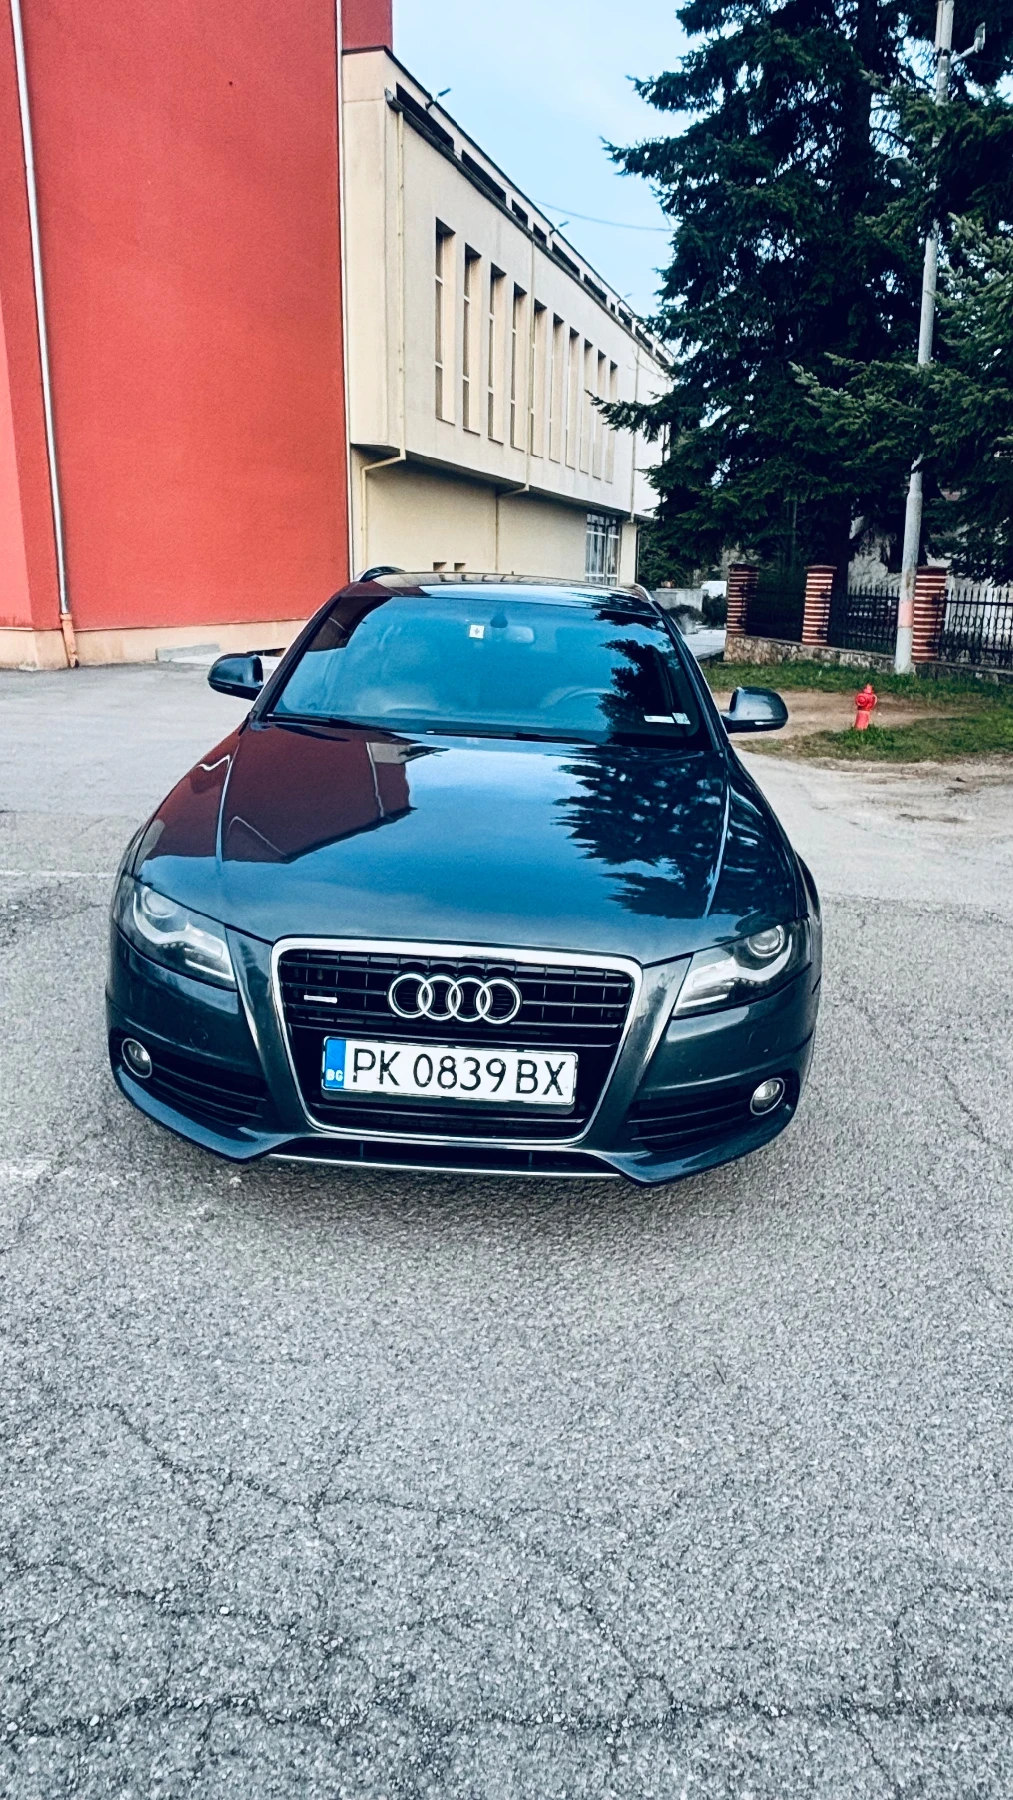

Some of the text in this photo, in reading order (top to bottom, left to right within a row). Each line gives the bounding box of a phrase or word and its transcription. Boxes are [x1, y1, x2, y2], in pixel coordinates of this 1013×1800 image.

[326, 1069, 344, 1082] BG
[352, 1048, 566, 1096] PK 0839 BX
